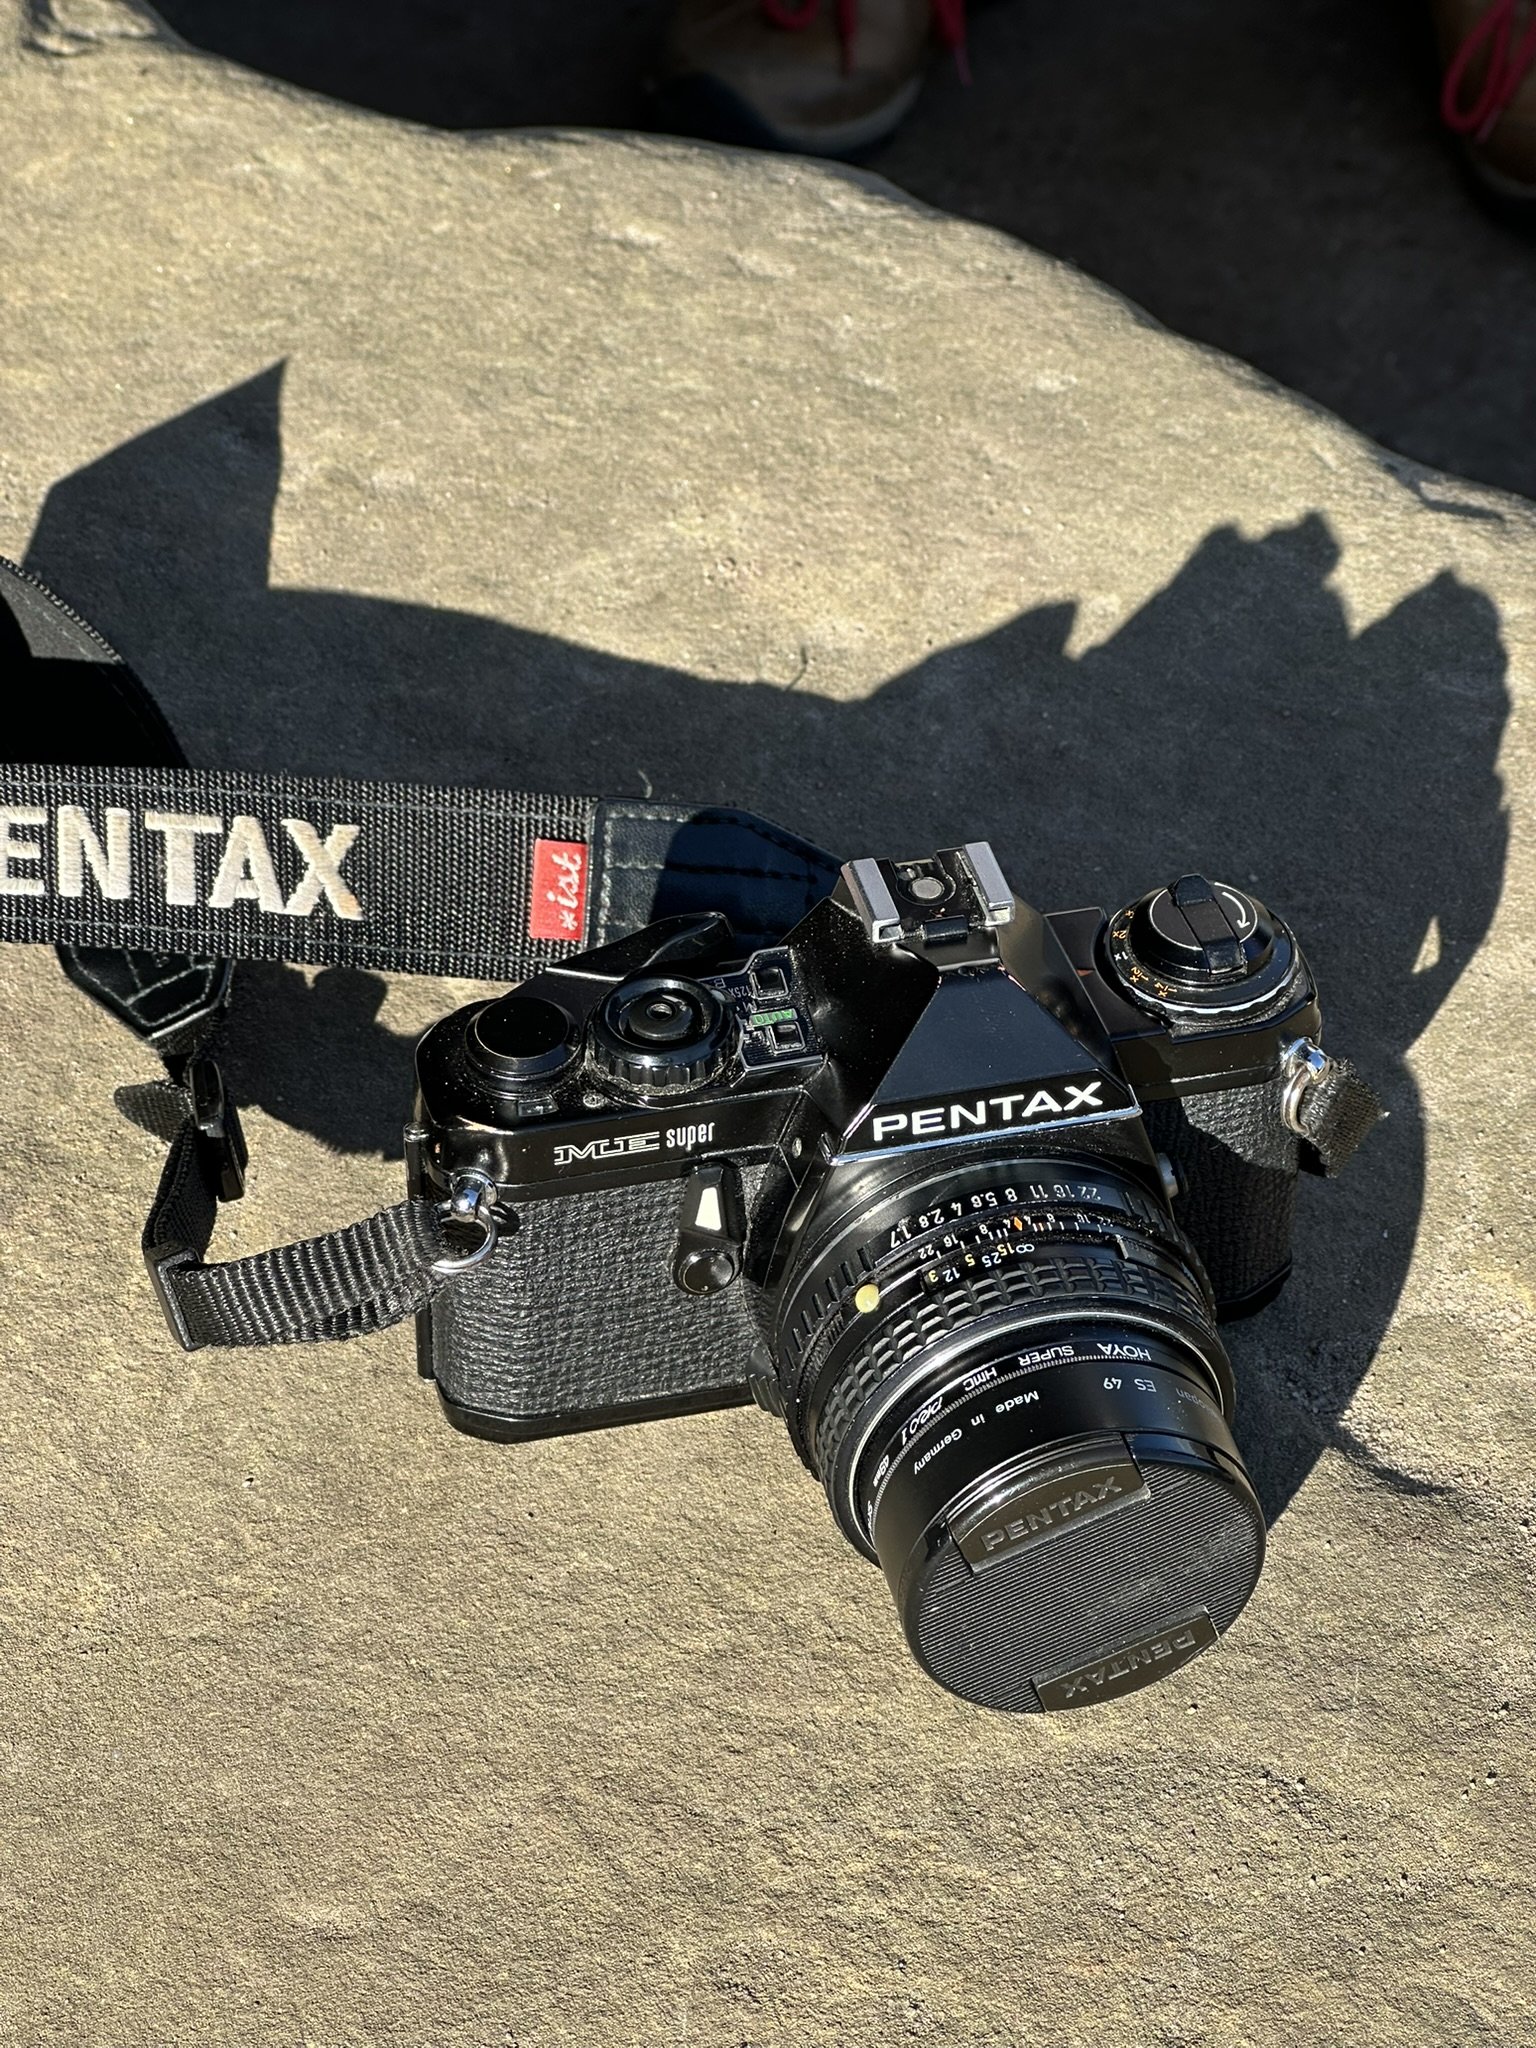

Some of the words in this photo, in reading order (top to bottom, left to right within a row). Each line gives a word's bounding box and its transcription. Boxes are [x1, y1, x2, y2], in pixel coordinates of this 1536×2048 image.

[754, 1009, 795, 1025] AUTO
[872, 1081, 1104, 1142] PENTAX
[554, 1131, 660, 1166] ME
[666, 1122, 715, 1148] super
[970, 1191, 998, 1208] 5.6
[1004, 1187, 1018, 1202] 8
[1029, 1184, 1049, 1199] 11
[950, 1202, 962, 1217] 4
[918, 1208, 945, 1228] 2.8
[890, 1225, 912, 1249] 1.7
[979, 1224, 989, 1235] 8
[943, 1233, 959, 1248] 16
[917, 1244, 935, 1260] 22
[997, 1242, 1015, 1257] 15
[964, 1253, 976, 1267] 5
[981, 1251, 1002, 1268] 25
[928, 1269, 939, 1283] 3
[942, 1267, 960, 1283] 12
[1018, 1345, 1075, 1367] SUPER
[1097, 1343, 1152, 1361] HOYA
[1103, 1377, 1122, 1390] 49
[1134, 1378, 1157, 1393] ES
[995, 1390, 1040, 1414] Made
[970, 1413, 986, 1427] in
[914, 1428, 963, 1475] Germany
[980, 1475, 1123, 1552] PENTAX
[1058, 1629, 1197, 1699] PENTAX
